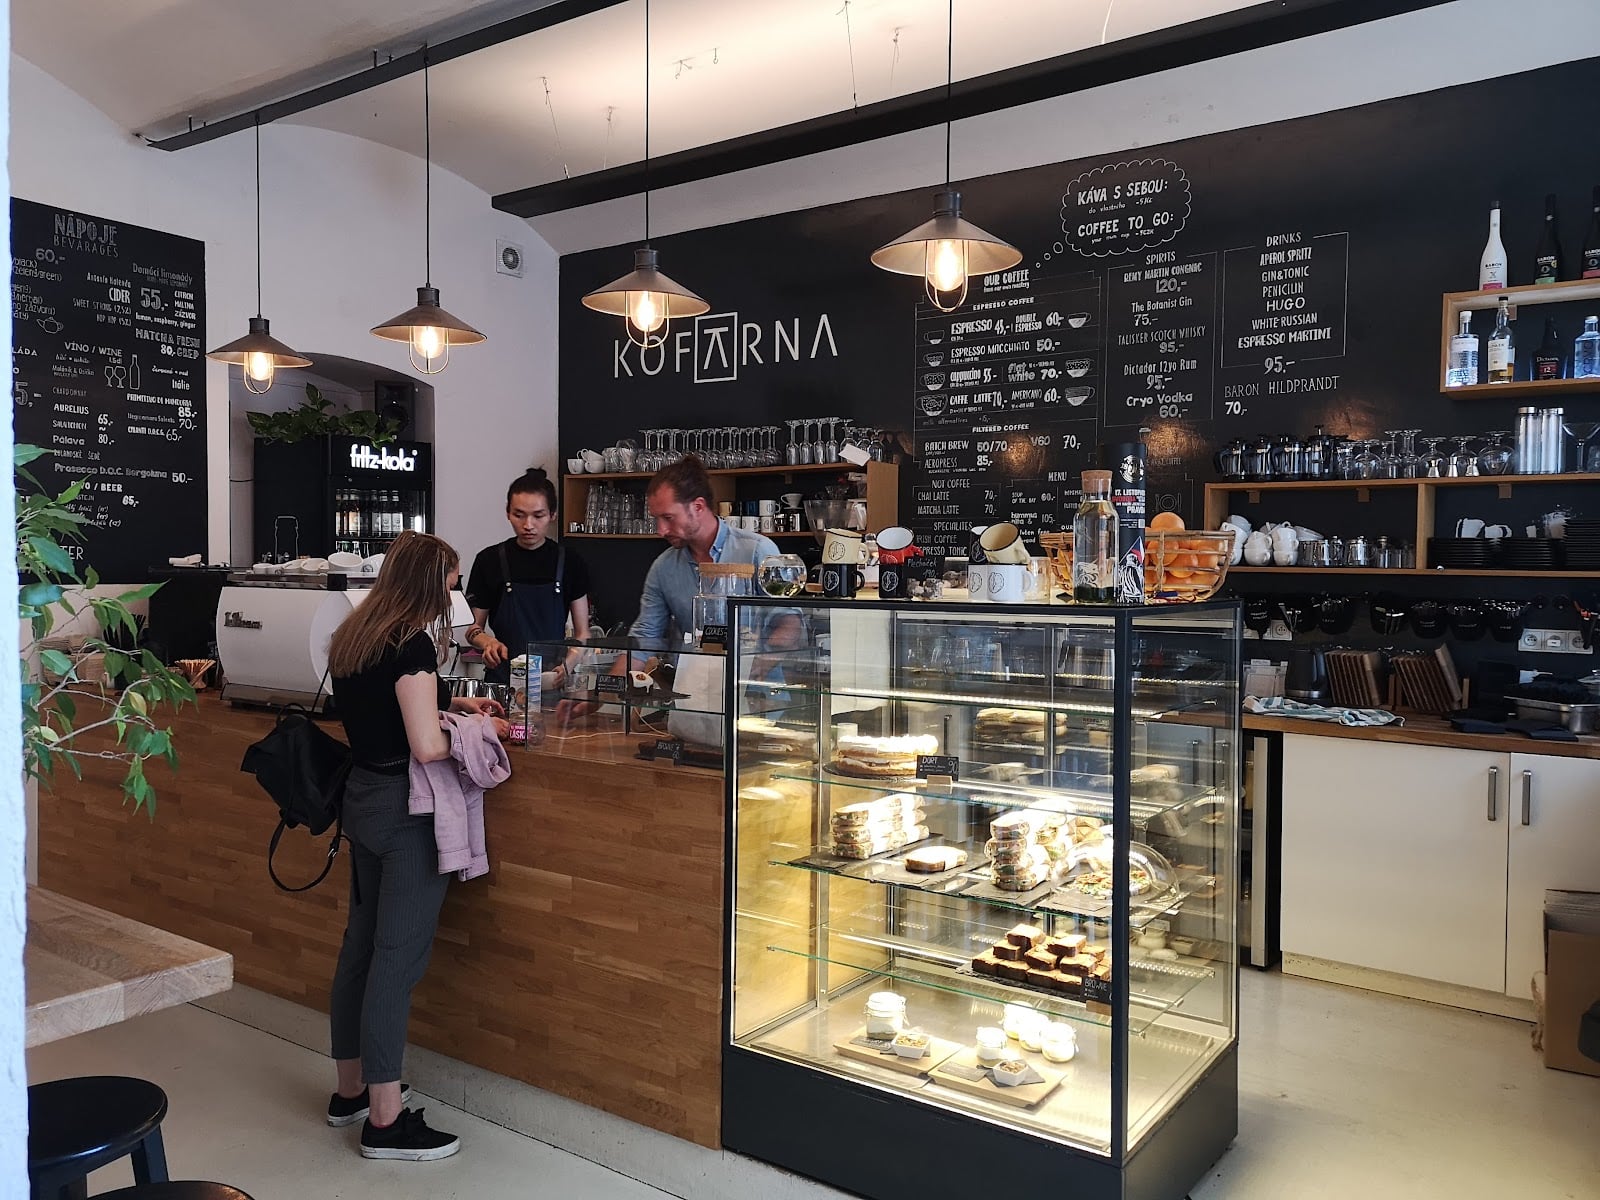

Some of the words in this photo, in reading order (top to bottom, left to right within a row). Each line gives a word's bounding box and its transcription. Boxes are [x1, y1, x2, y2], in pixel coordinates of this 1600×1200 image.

[1077, 186, 1107, 206] KÁVA
[1113, 185, 1121, 199] S
[1126, 179, 1168, 197] SEBOU:
[54, 212, 118, 247] NÁPOJE
[1077, 219, 1119, 237] COFFEE
[1127, 215, 1144, 230] TO
[1152, 211, 1174, 226] GO:
[53, 235, 119, 257] BEVARAGES
[1266, 231, 1301, 247] DRINKS
[1145, 251, 1176, 265] SPIRITS
[1259, 250, 1286, 267] APEROL
[1287, 246, 1312, 262] SPRITZ
[983, 274, 1000, 287] OUR
[1002, 269, 1030, 284] COFFEE
[1123, 270, 1143, 283] REMY
[1144, 266, 1170, 280] MARTIN
[1261, 265, 1310, 283] GIN&TONIC
[108, 287, 131, 304] CIDER
[972, 300, 1006, 311] ESPRESSO
[1008, 296, 1035, 306] COFFEE
[1131, 302, 1145, 314] The
[1146, 298, 1177, 312] Botanist
[1179, 296, 1193, 307] Gin
[1266, 297, 1306, 312] HUGO
[951, 319, 993, 335] ESPRESSO
[1015, 320, 1043, 333] ESPRESSO
[1118, 331, 1149, 346] TALISKER
[1150, 328, 1177, 342] SCOTCH
[1179, 325, 1207, 339] WHISKY
[1237, 332, 1286, 349] ESPRESSO
[1288, 327, 1332, 344] MARTINI
[64, 340, 90, 353] VÍNO
[98, 346, 123, 357] WINE
[951, 345, 986, 359] ESPRESSO
[1123, 362, 1156, 376] Dictador
[1179, 359, 1197, 370] Rum
[1224, 382, 1260, 398] BARON
[1268, 375, 1340, 395] HILDPRANDT
[973, 392, 993, 404] LATTE
[1126, 395, 1153, 408] Cryo
[1157, 392, 1193, 405] Vodka
[53, 403, 90, 415] AURELIUS
[972, 425, 1002, 433] FILTERED
[1003, 423, 1030, 431] COFFEE
[924, 441, 947, 452] BATCH
[947, 439, 970, 451] BREW
[54, 462, 98, 475] Prosecco
[924, 457, 958, 469] AEROPRESS
[931, 479, 945, 489] NOT
[946, 478, 971, 489] COFFEE
[1048, 471, 1068, 482] MENU
[100, 483, 123, 493] BEER
[917, 491, 932, 501] CHAI
[932, 490, 950, 501] LATTE
[917, 505, 942, 515] MATCHA
[942, 505, 960, 515] LATTE
[934, 534, 958, 544] COFFEE
[949, 546, 968, 556] TONIC
